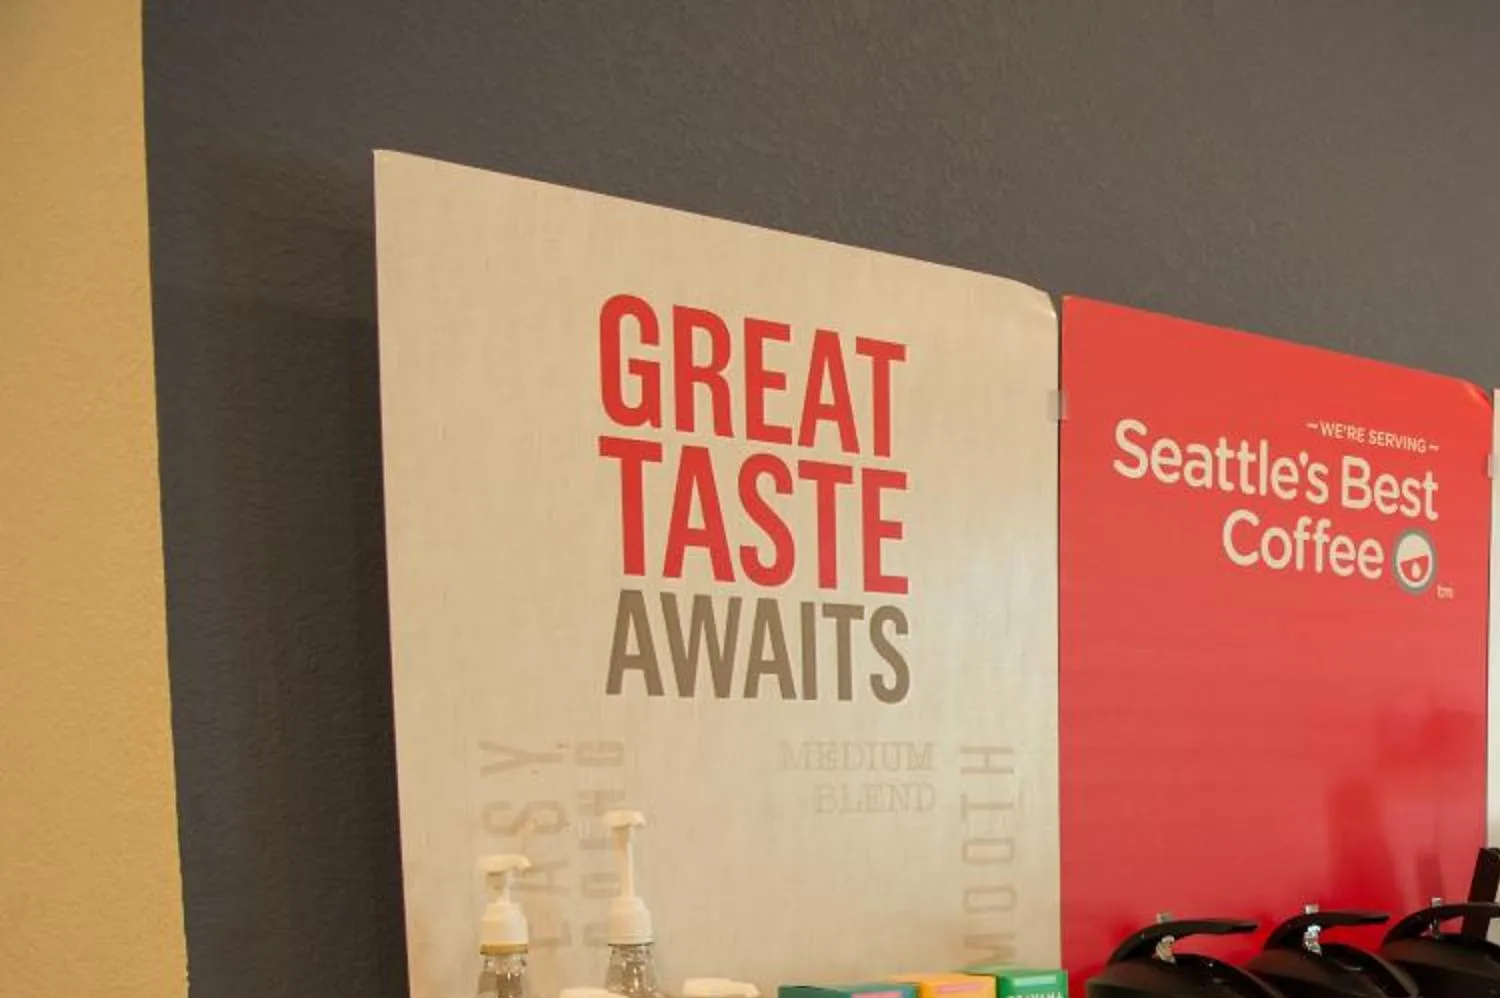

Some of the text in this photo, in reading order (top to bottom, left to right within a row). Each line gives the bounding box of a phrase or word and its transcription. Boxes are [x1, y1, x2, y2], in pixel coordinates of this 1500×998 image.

[600, 293, 908, 458] GREAT
[1113, 418, 1439, 521] Seattle's Best
[1320, 421, 1427, 453] WE'RE SERVING
[599, 435, 909, 594] TASTE
[1222, 509, 1384, 579] Coffee
[606, 588, 910, 703] AWAITS
[777, 739, 936, 772] MEDIUM
[814, 782, 937, 814] BLEND
[960, 746, 1017, 967] MOOTH
